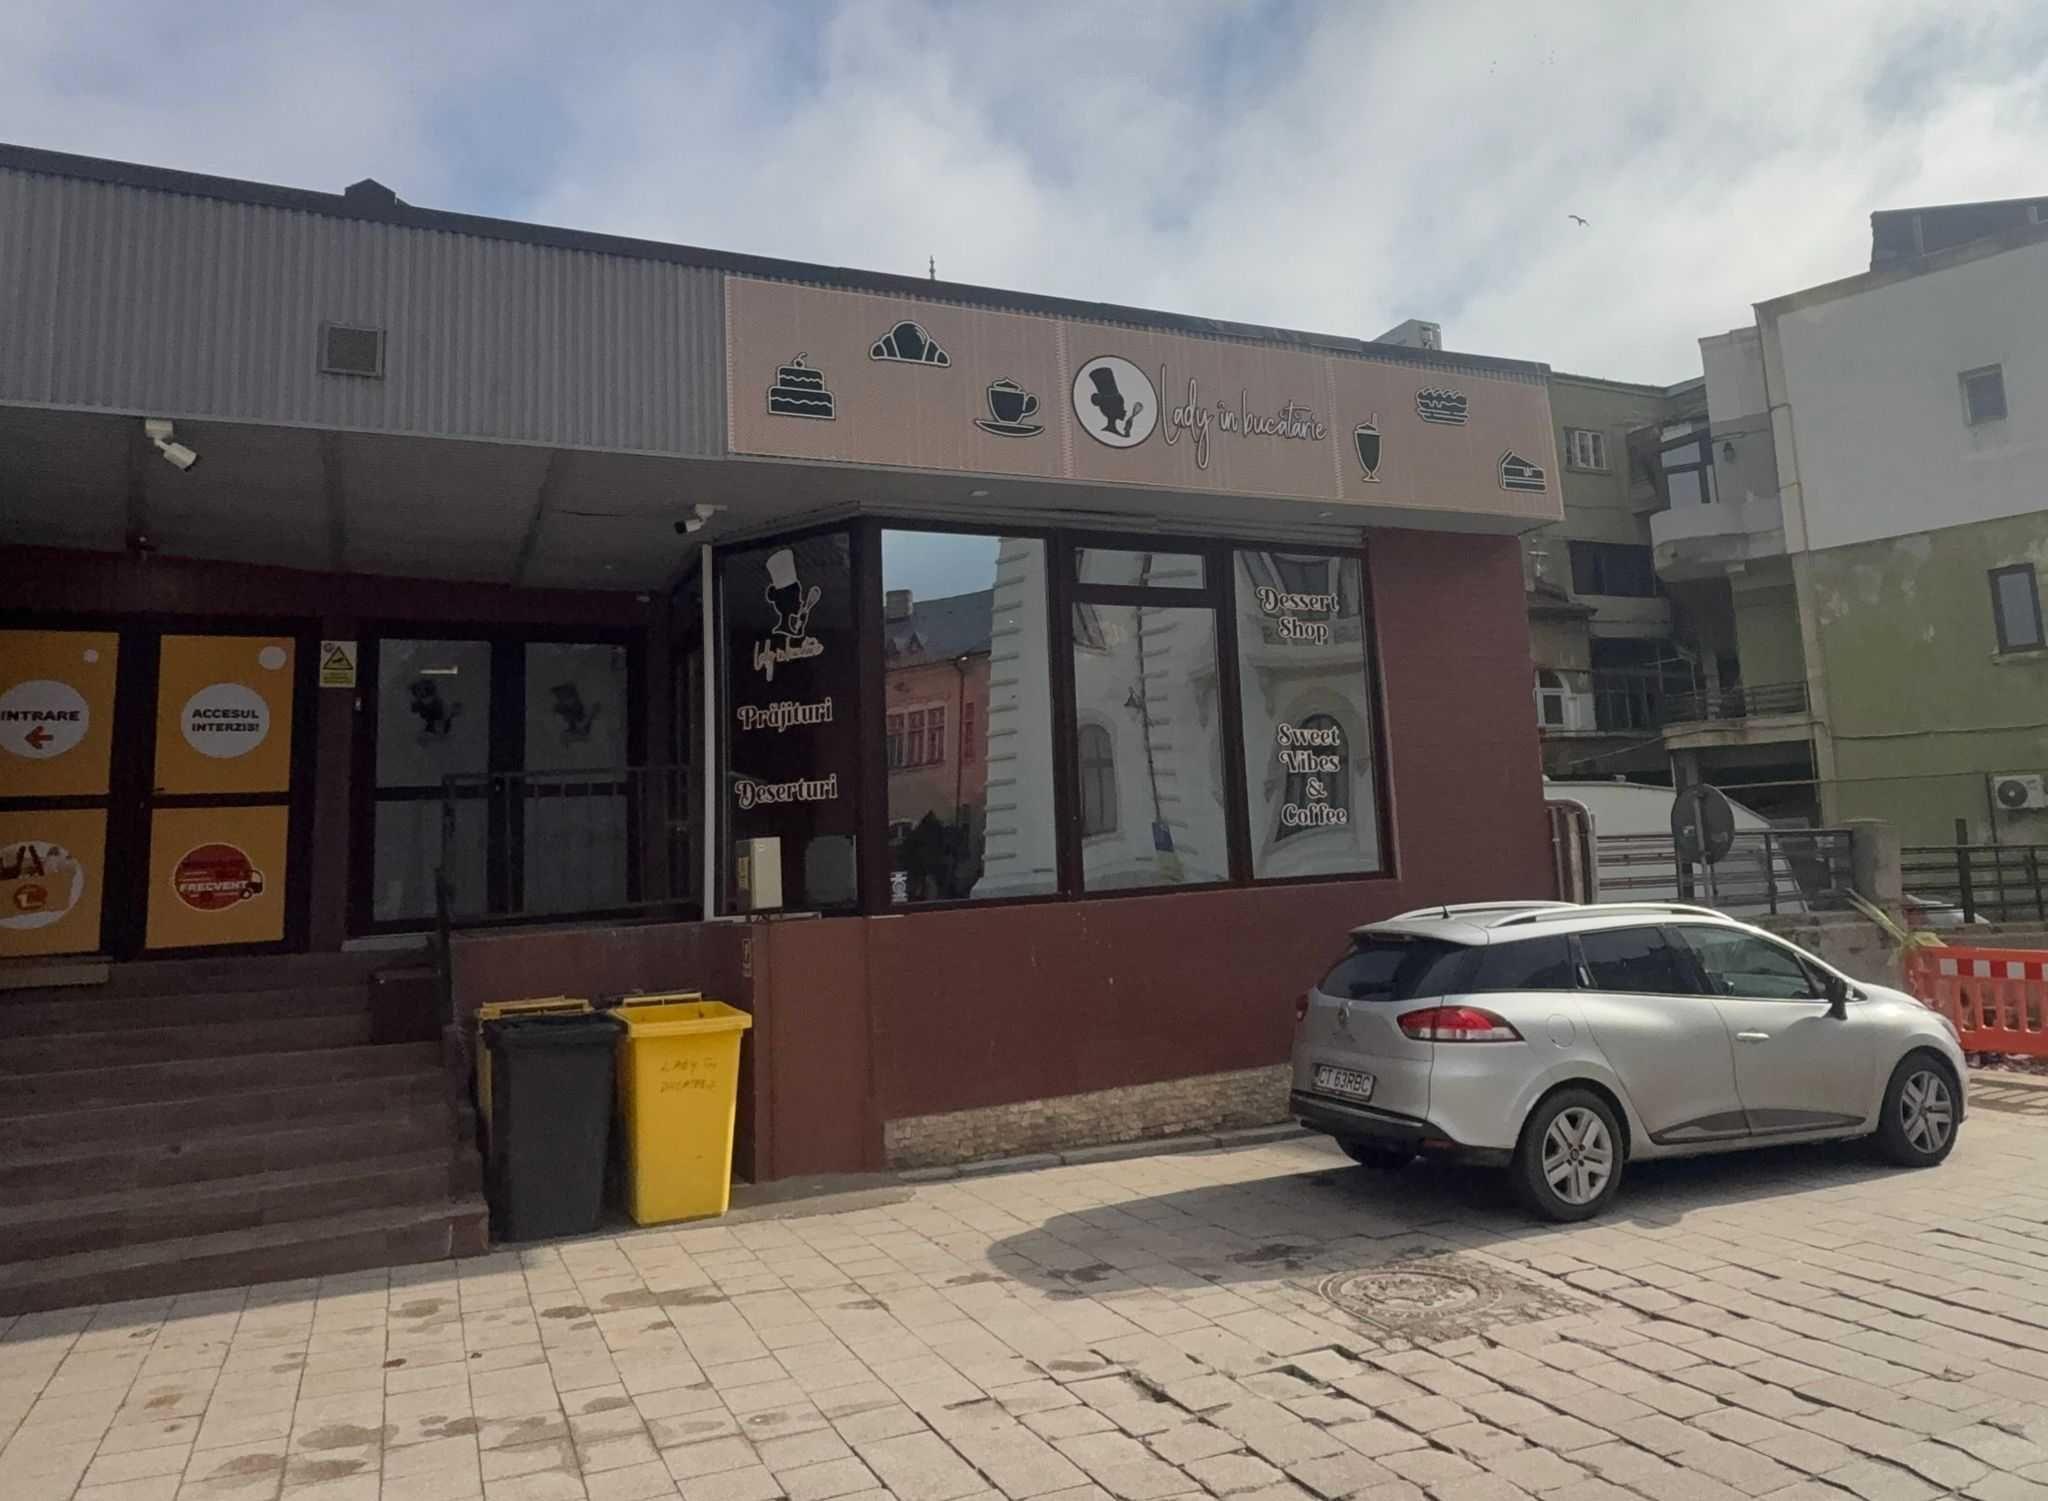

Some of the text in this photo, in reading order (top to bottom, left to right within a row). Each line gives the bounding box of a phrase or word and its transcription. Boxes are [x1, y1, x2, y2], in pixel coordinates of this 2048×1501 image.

[1160, 362, 1214, 470] Lady
[1257, 586, 1340, 613] Dessert
[1279, 616, 1329, 645] Shop
[0, 710, 81, 721] INTRARE
[192, 709, 260, 719] ACCESUL
[192, 723, 260, 732] INTERZIS!
[1278, 723, 1341, 746] Sweet
[1279, 750, 1341, 773] Vibes
[735, 773, 838, 810] Deserturi
[1306, 777, 1328, 799] &
[1281, 803, 1348, 826] Coffee
